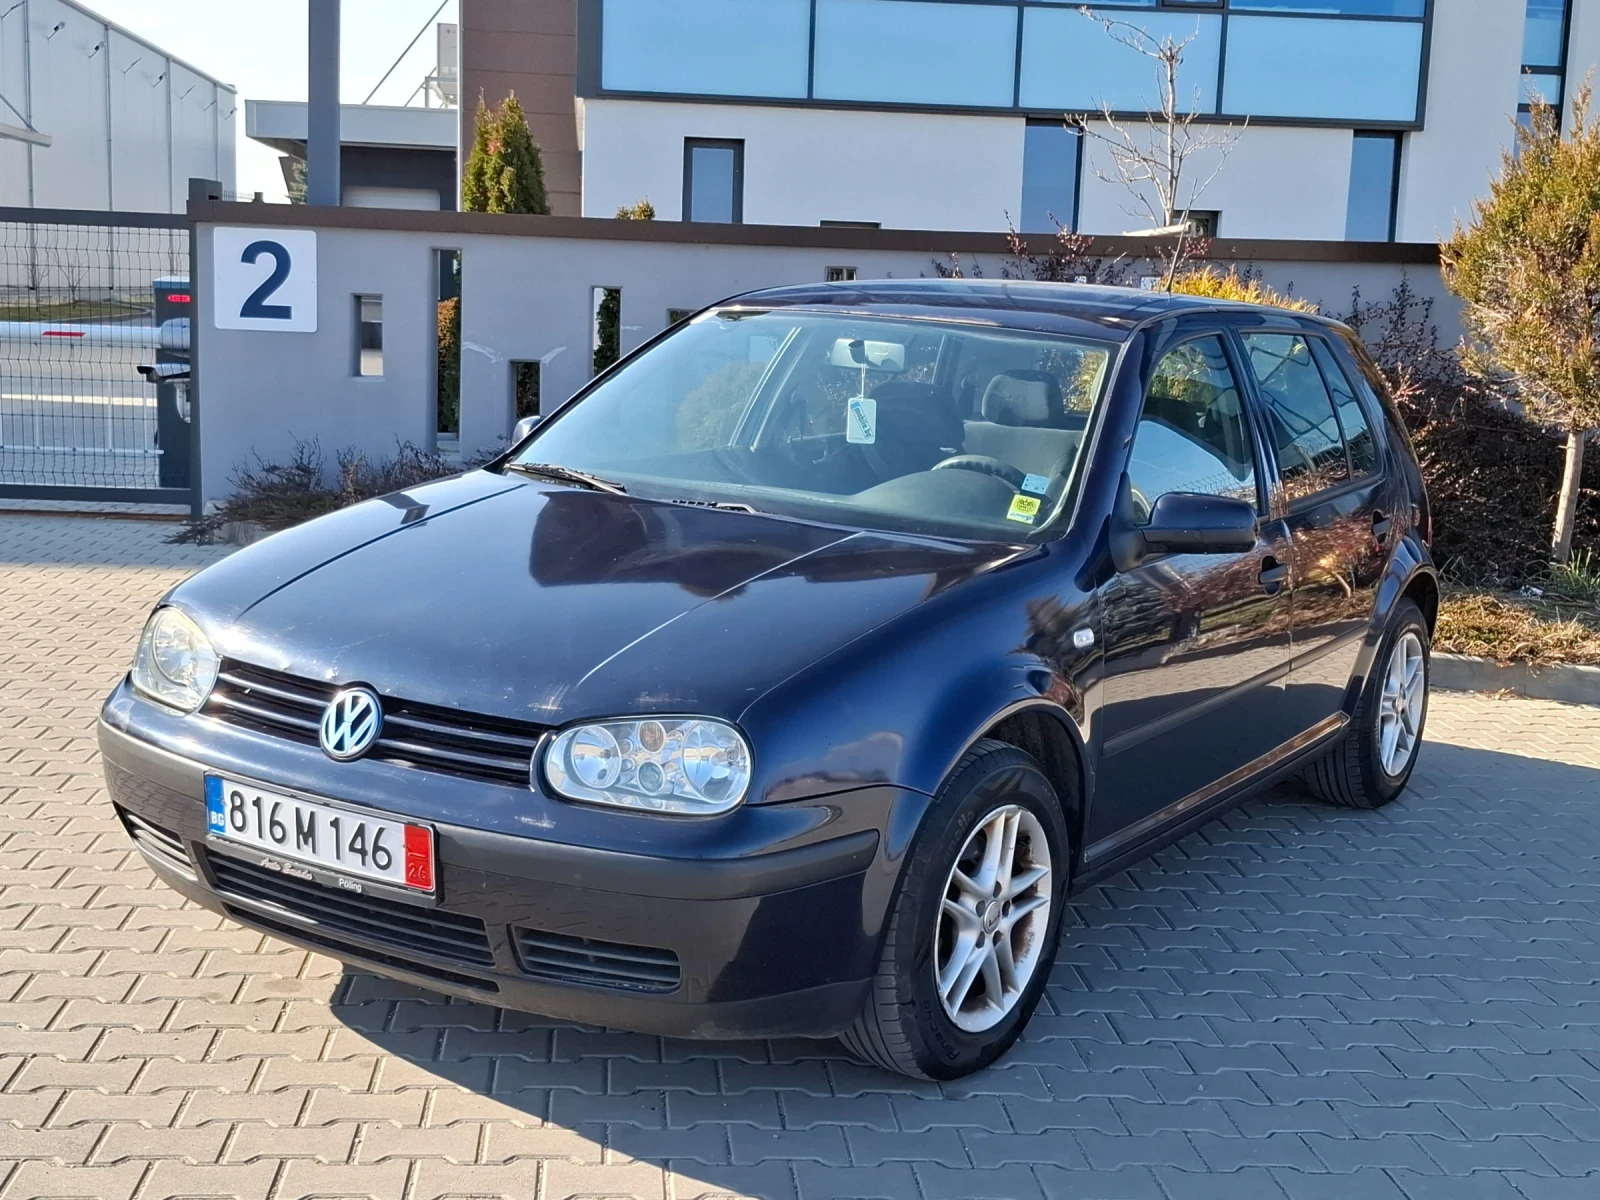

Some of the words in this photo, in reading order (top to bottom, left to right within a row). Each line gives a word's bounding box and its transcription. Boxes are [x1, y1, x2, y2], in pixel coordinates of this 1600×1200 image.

[239, 240, 293, 320] 2
[853, 407, 872, 438] mobile.bg
[320, 687, 382, 759] VW
[210, 811, 225, 827] BG
[229, 789, 287, 845] 816
[295, 806, 317, 855] M
[329, 816, 393, 871] 146
[408, 862, 426, 879] 26
